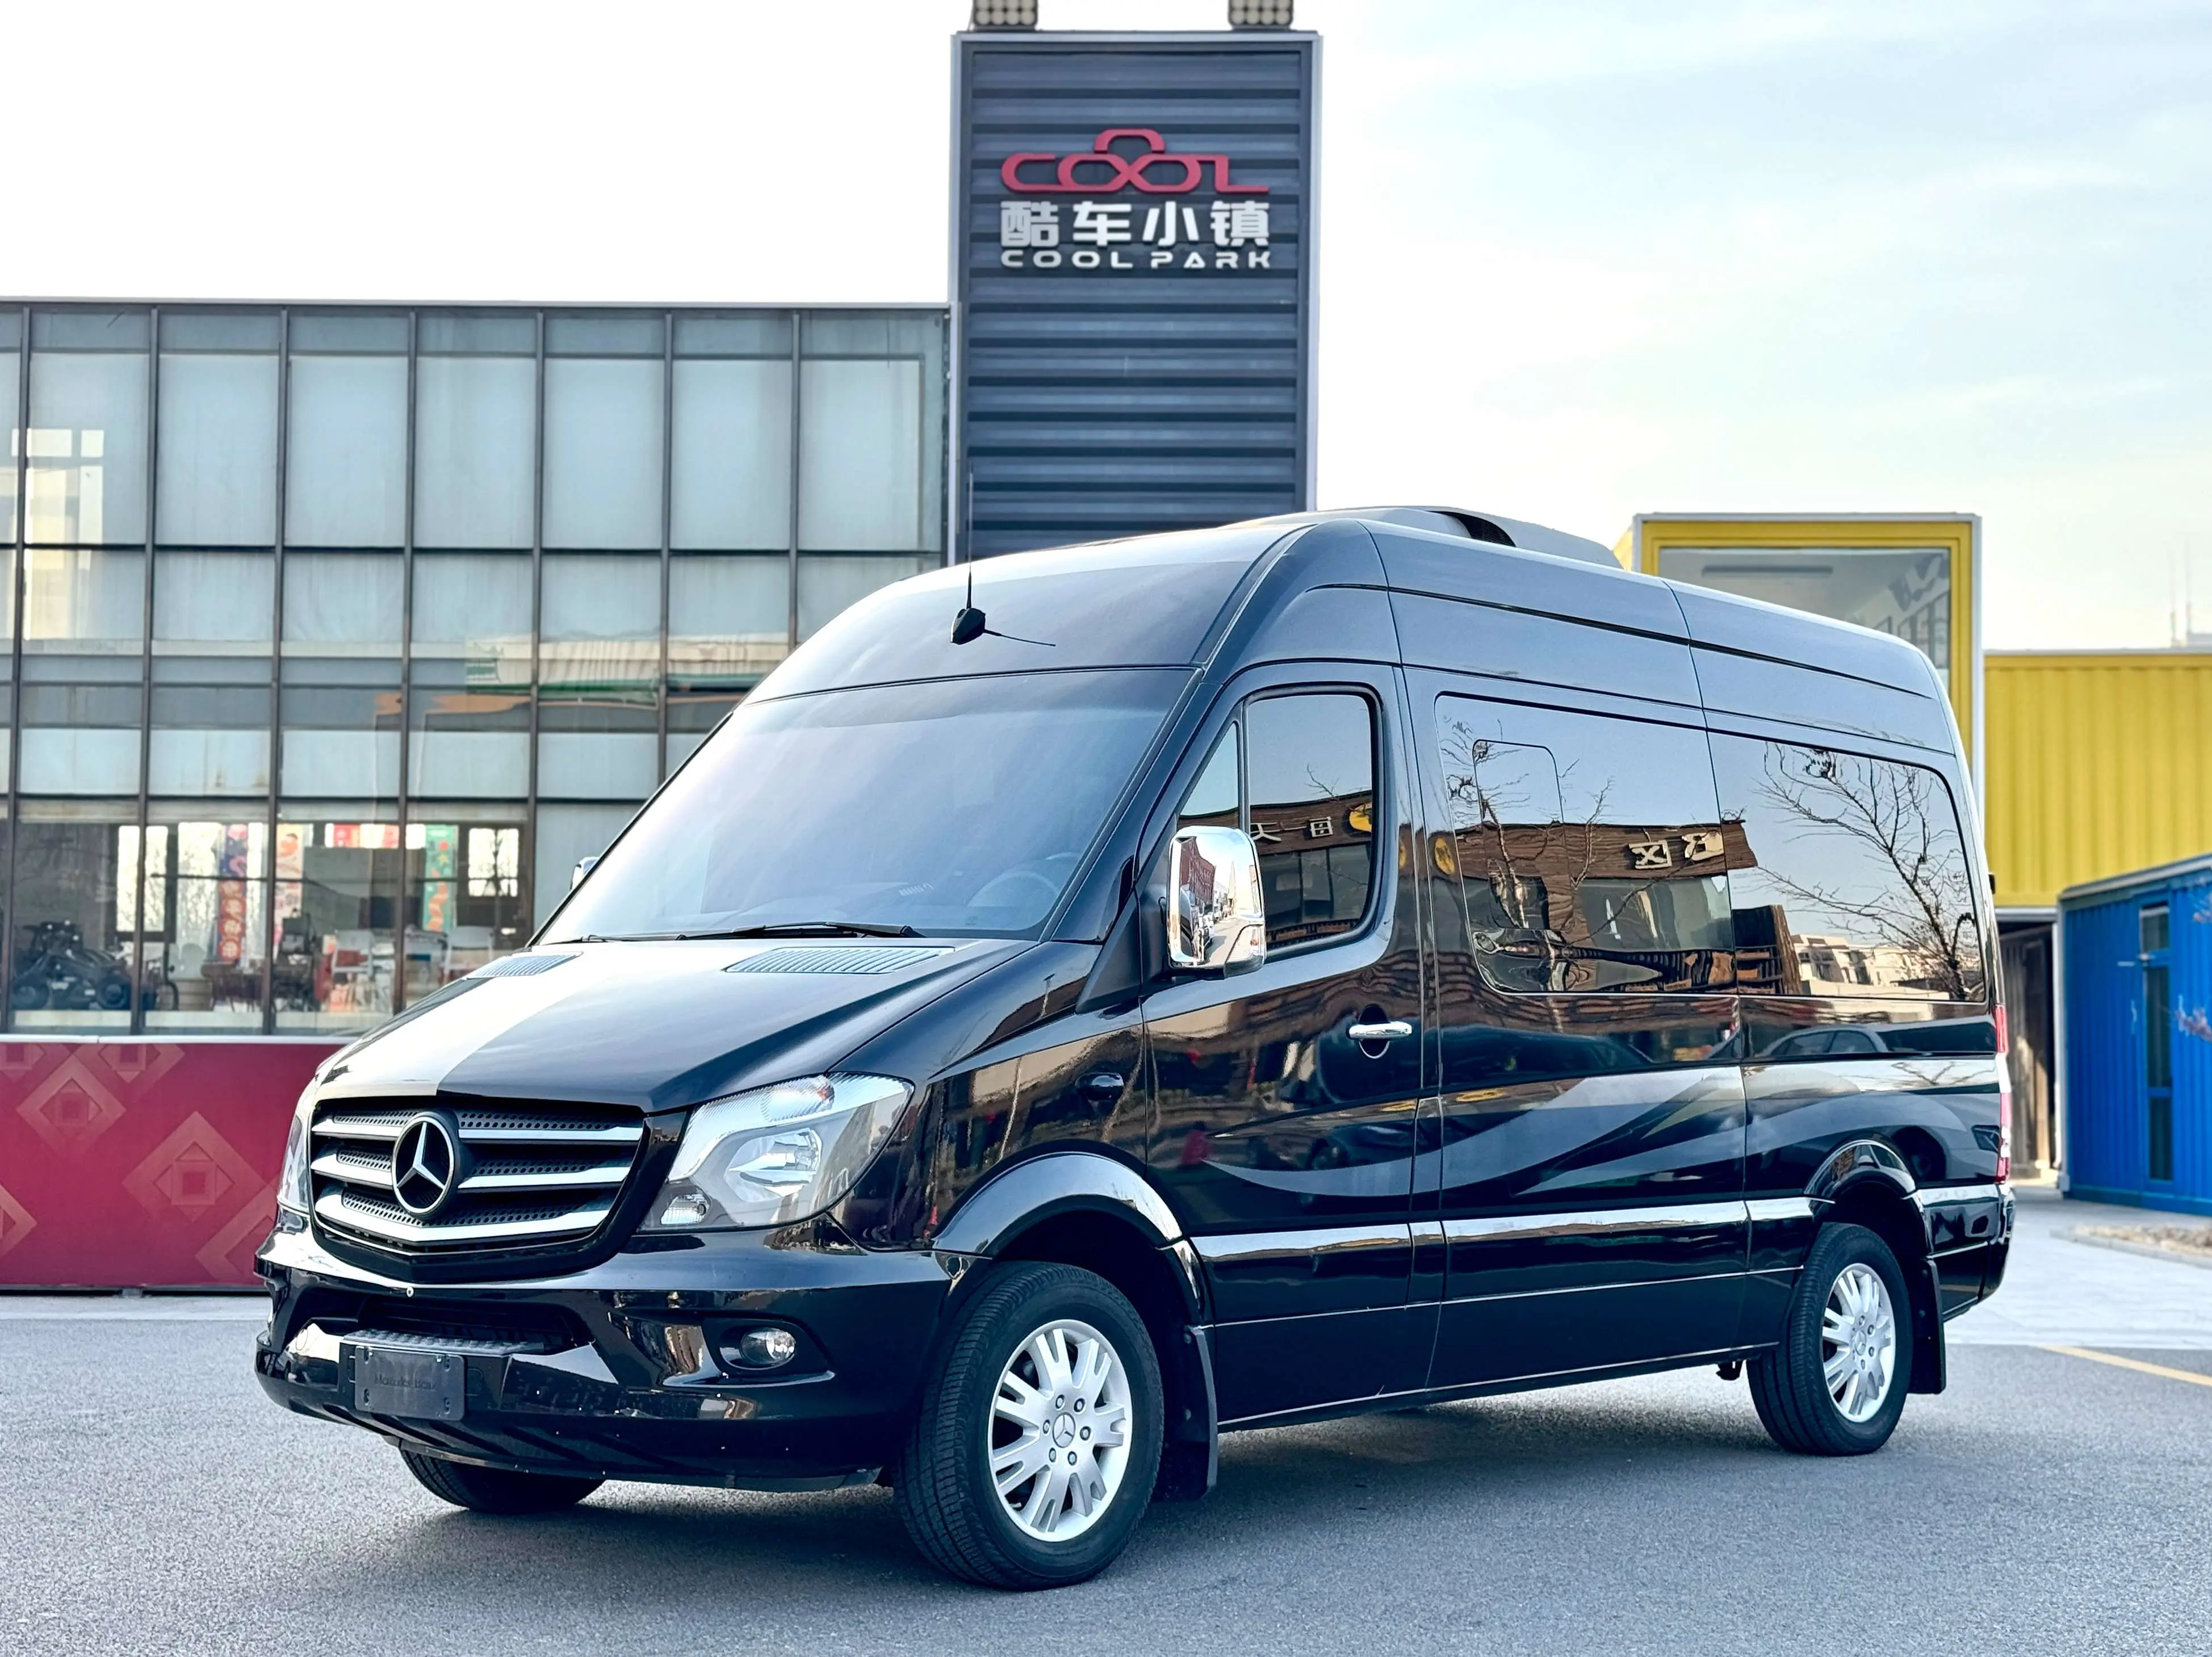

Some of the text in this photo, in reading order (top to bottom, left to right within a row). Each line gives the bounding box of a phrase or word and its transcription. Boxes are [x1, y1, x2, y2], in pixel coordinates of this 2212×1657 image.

[1001, 201, 1270, 247] 酷车小镇
[1001, 250, 1270, 269] COOL PARK
